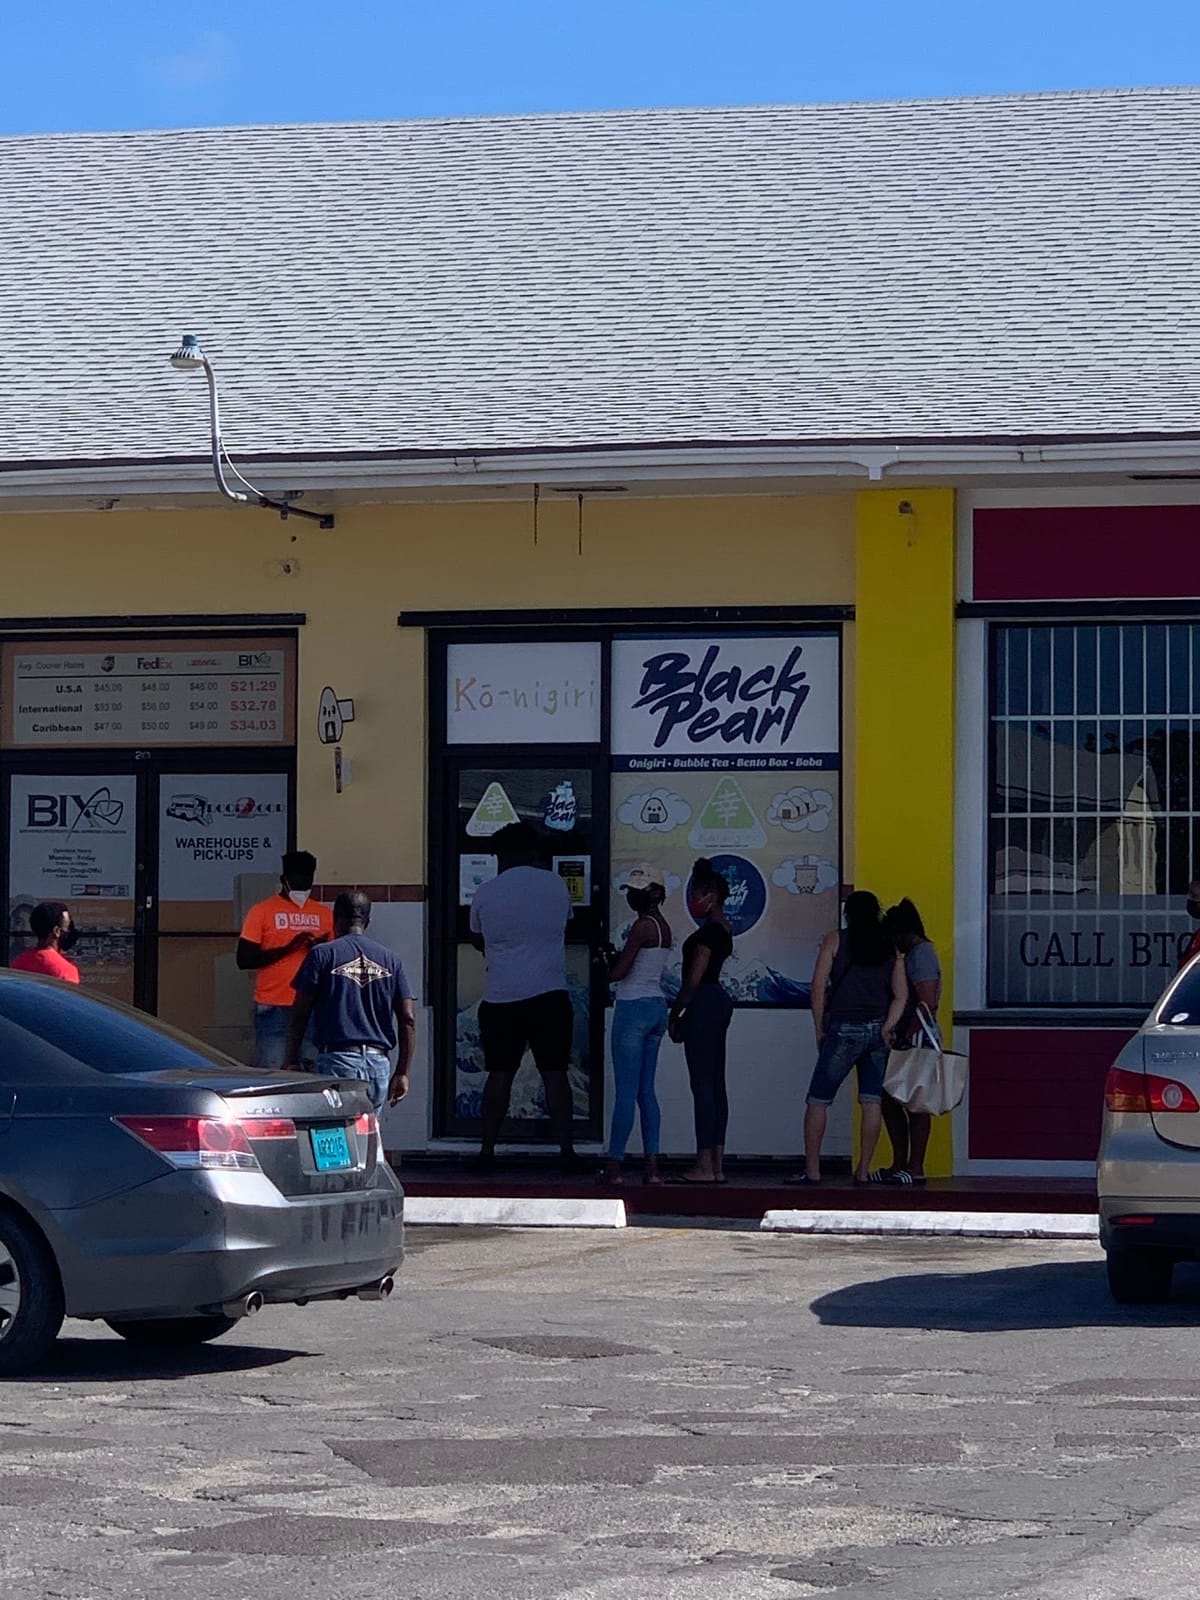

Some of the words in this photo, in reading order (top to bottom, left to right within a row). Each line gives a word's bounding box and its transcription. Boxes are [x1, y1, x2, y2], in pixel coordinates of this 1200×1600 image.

[136, 656, 174, 670] FedEx
[631, 645, 807, 709] Black
[55, 684, 83, 693] U.S.A
[230, 680, 277, 692] $21.29
[18, 704, 83, 714] International
[230, 700, 276, 711] $32.78
[649, 685, 810, 748] Pearl
[32, 723, 82, 732] Caribbean
[229, 720, 276, 731] $34.03
[628, 757, 666, 770] Onigiri
[673, 757, 710, 769] Bubble
[711, 757, 730, 768] Tea
[737, 757, 767, 768] Bento
[768, 757, 789, 768] Box
[796, 756, 823, 767] Boba
[27, 787, 112, 832] BIX
[175, 837, 258, 849] WAREHOUSE
[262, 837, 272, 848] &
[193, 849, 254, 861] PICK-UPS
[1020, 931, 1114, 967] CALL
